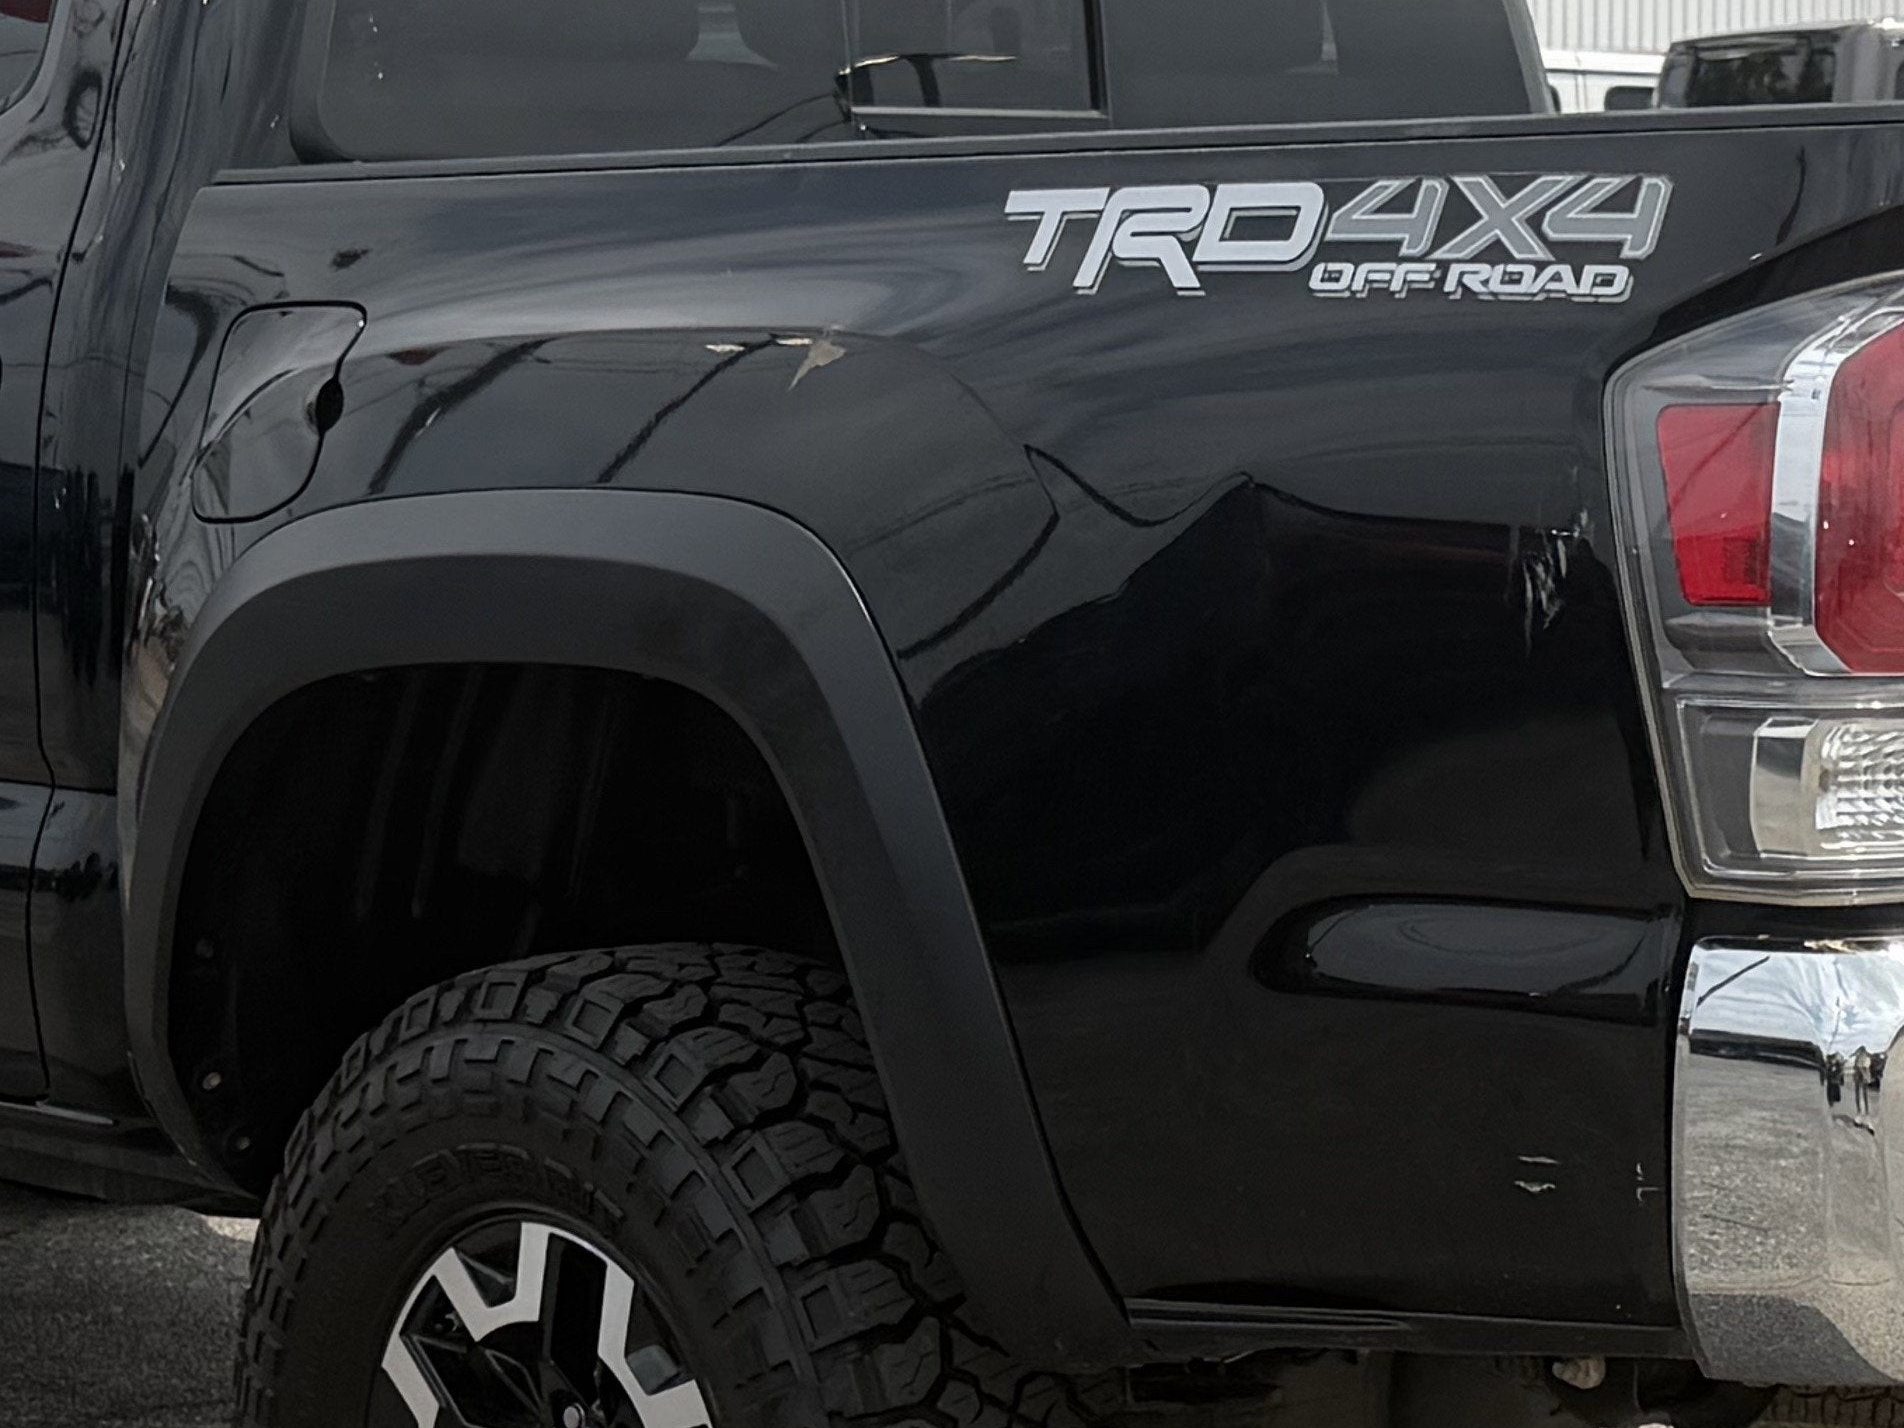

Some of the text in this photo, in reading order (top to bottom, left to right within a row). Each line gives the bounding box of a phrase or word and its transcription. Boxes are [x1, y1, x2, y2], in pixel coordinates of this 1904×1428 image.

[1004, 175, 1674, 295] TRD 4X4
[1308, 261, 1634, 303] OFF ROAD
